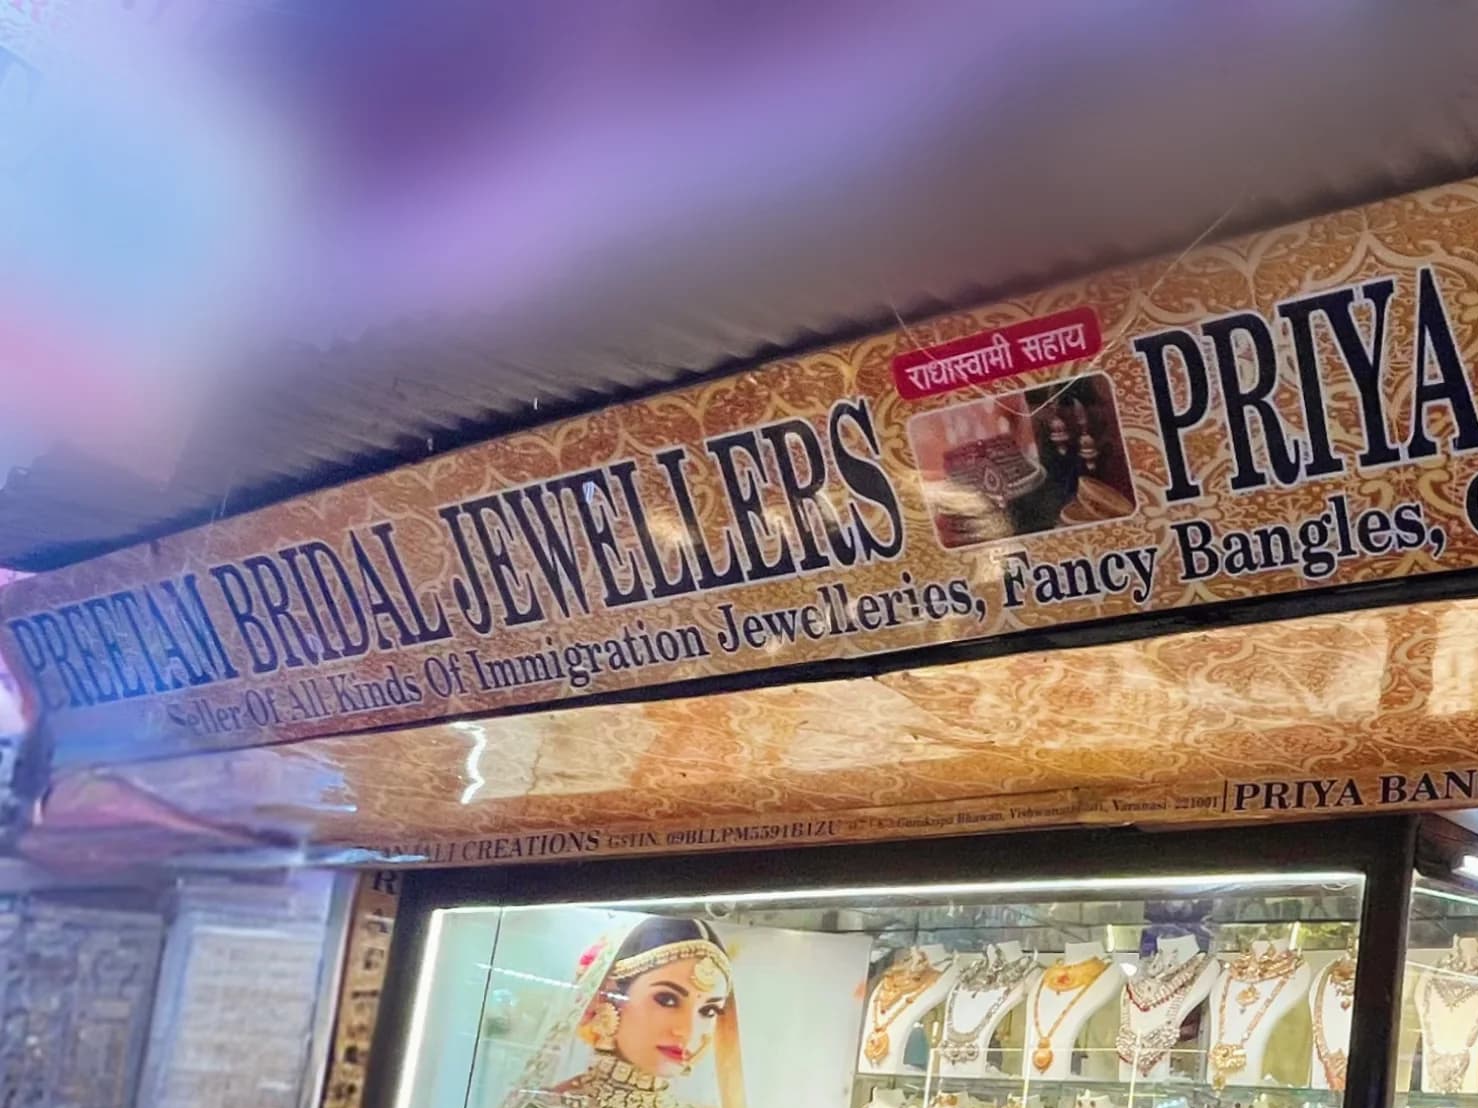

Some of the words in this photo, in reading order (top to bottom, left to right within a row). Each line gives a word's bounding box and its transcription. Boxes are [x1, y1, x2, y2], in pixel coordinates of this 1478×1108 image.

[905, 333, 1014, 390] राधास्वामी
[1018, 323, 1087, 362] सहाय
[8, 573, 239, 706] PREETAM
[211, 522, 452, 673] BRIDAL
[442, 399, 906, 633] JEWELLERS
[245, 687, 279, 727] Of
[288, 682, 329, 721] All
[328, 666, 421, 713] Kinds
[426, 650, 471, 699] Of
[470, 623, 707, 692] Immigration
[717, 574, 986, 653] Jewelleries,
[1002, 547, 1156, 607] Fancy
[1171, 502, 1446, 582] Bangles,
[1233, 778, 1364, 811] PRIYA
[462, 830, 600, 861] CREATIONS
